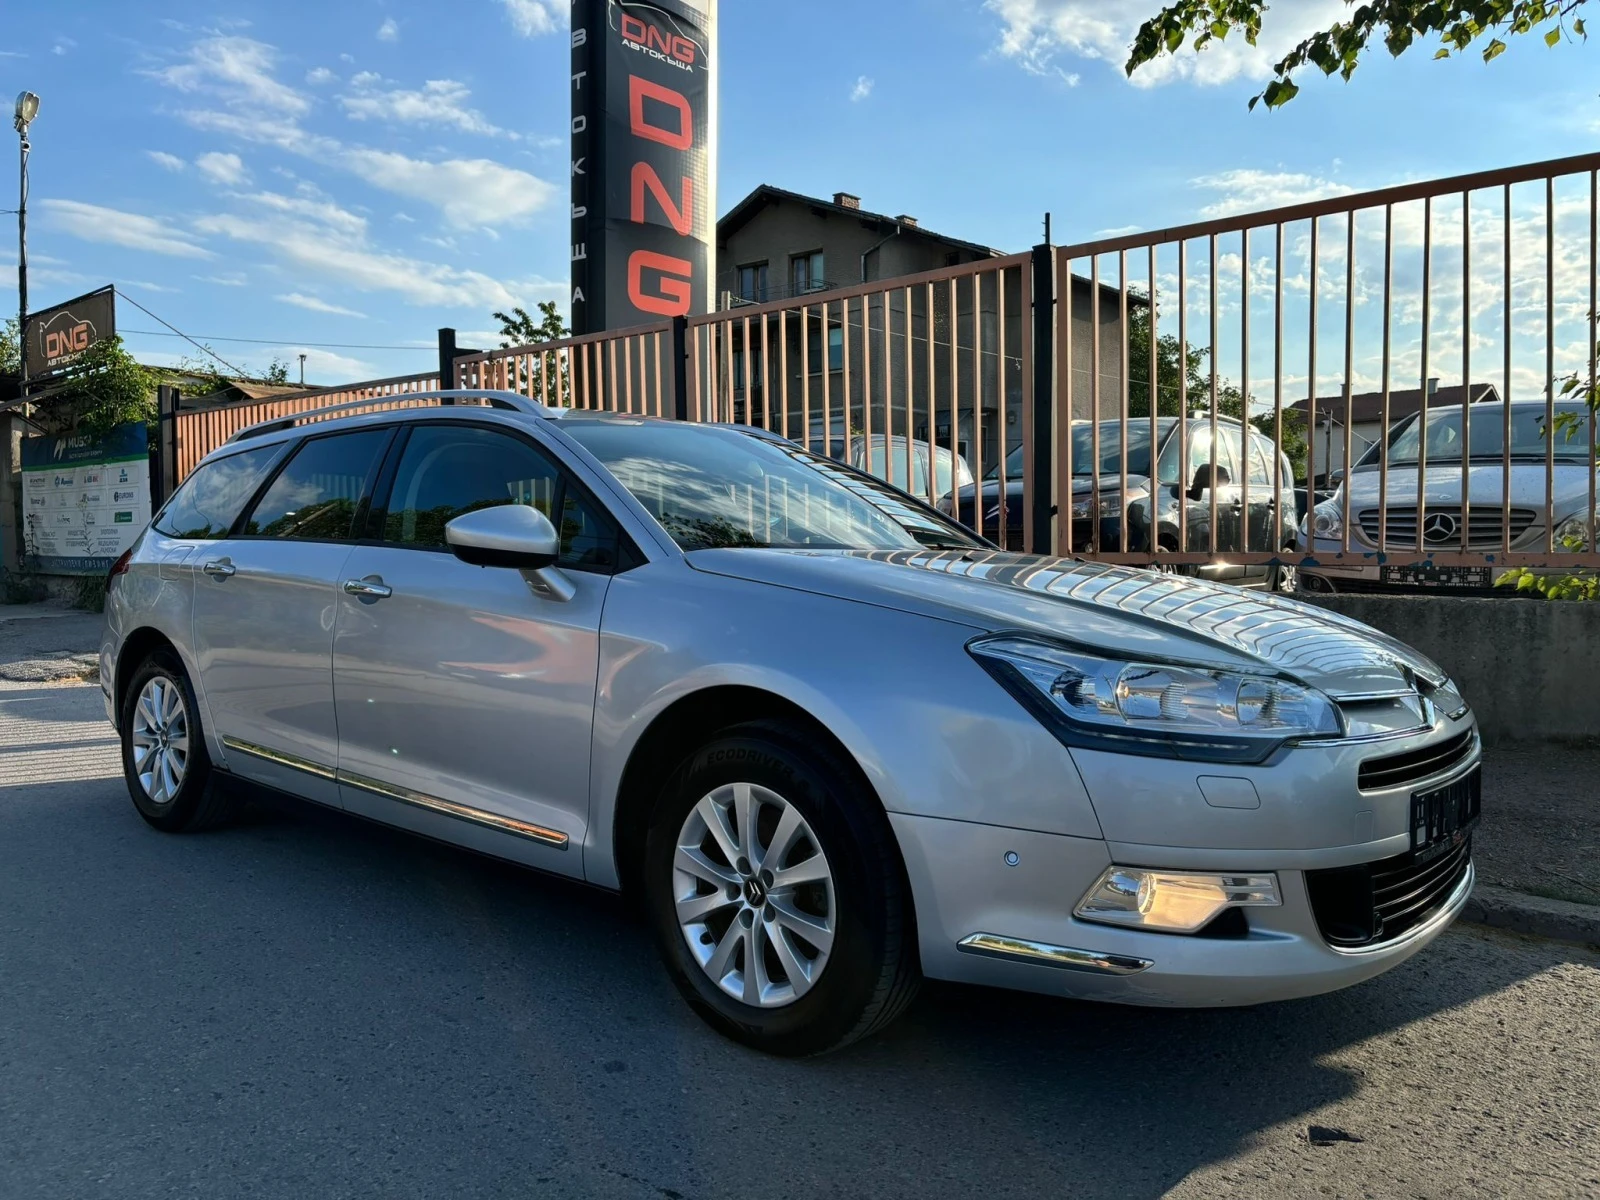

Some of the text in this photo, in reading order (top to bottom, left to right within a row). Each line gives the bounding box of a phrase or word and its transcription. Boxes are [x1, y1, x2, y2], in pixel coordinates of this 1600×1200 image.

[621, 13, 695, 64] DNG
[571, 0, 587, 303] ВТОКЪЩА
[627, 74, 693, 317] DNG
[46, 323, 88, 358] DNG
[707, 748, 796, 779] ECODRIVER
